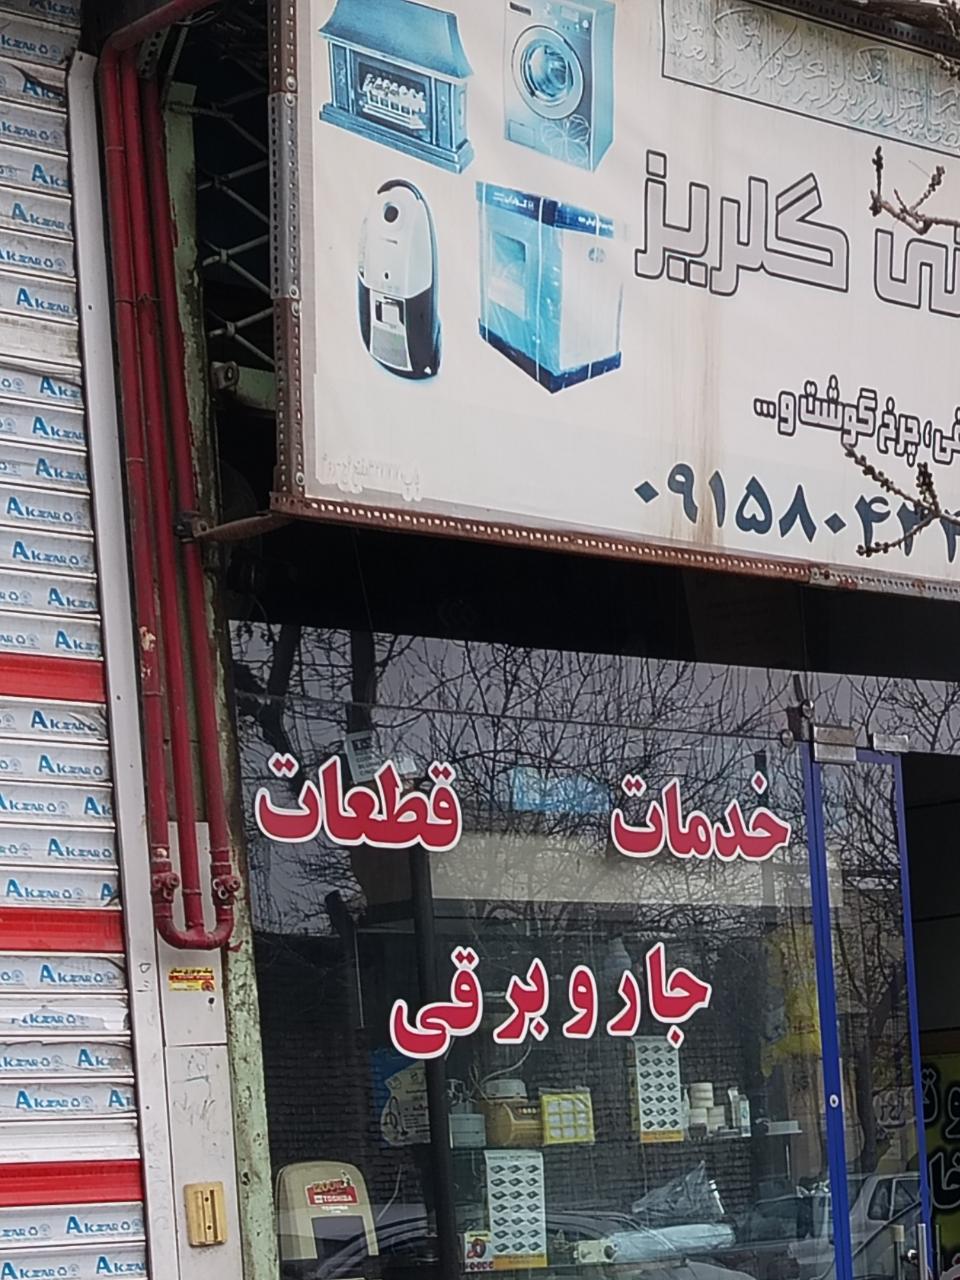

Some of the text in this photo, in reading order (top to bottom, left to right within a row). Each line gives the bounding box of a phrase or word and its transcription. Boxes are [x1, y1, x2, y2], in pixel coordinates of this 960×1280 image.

[635, 149, 848, 296] گلریز
[799, 374, 877, 448] گوشت
[254, 751, 794, 864] خدمات قطعات
